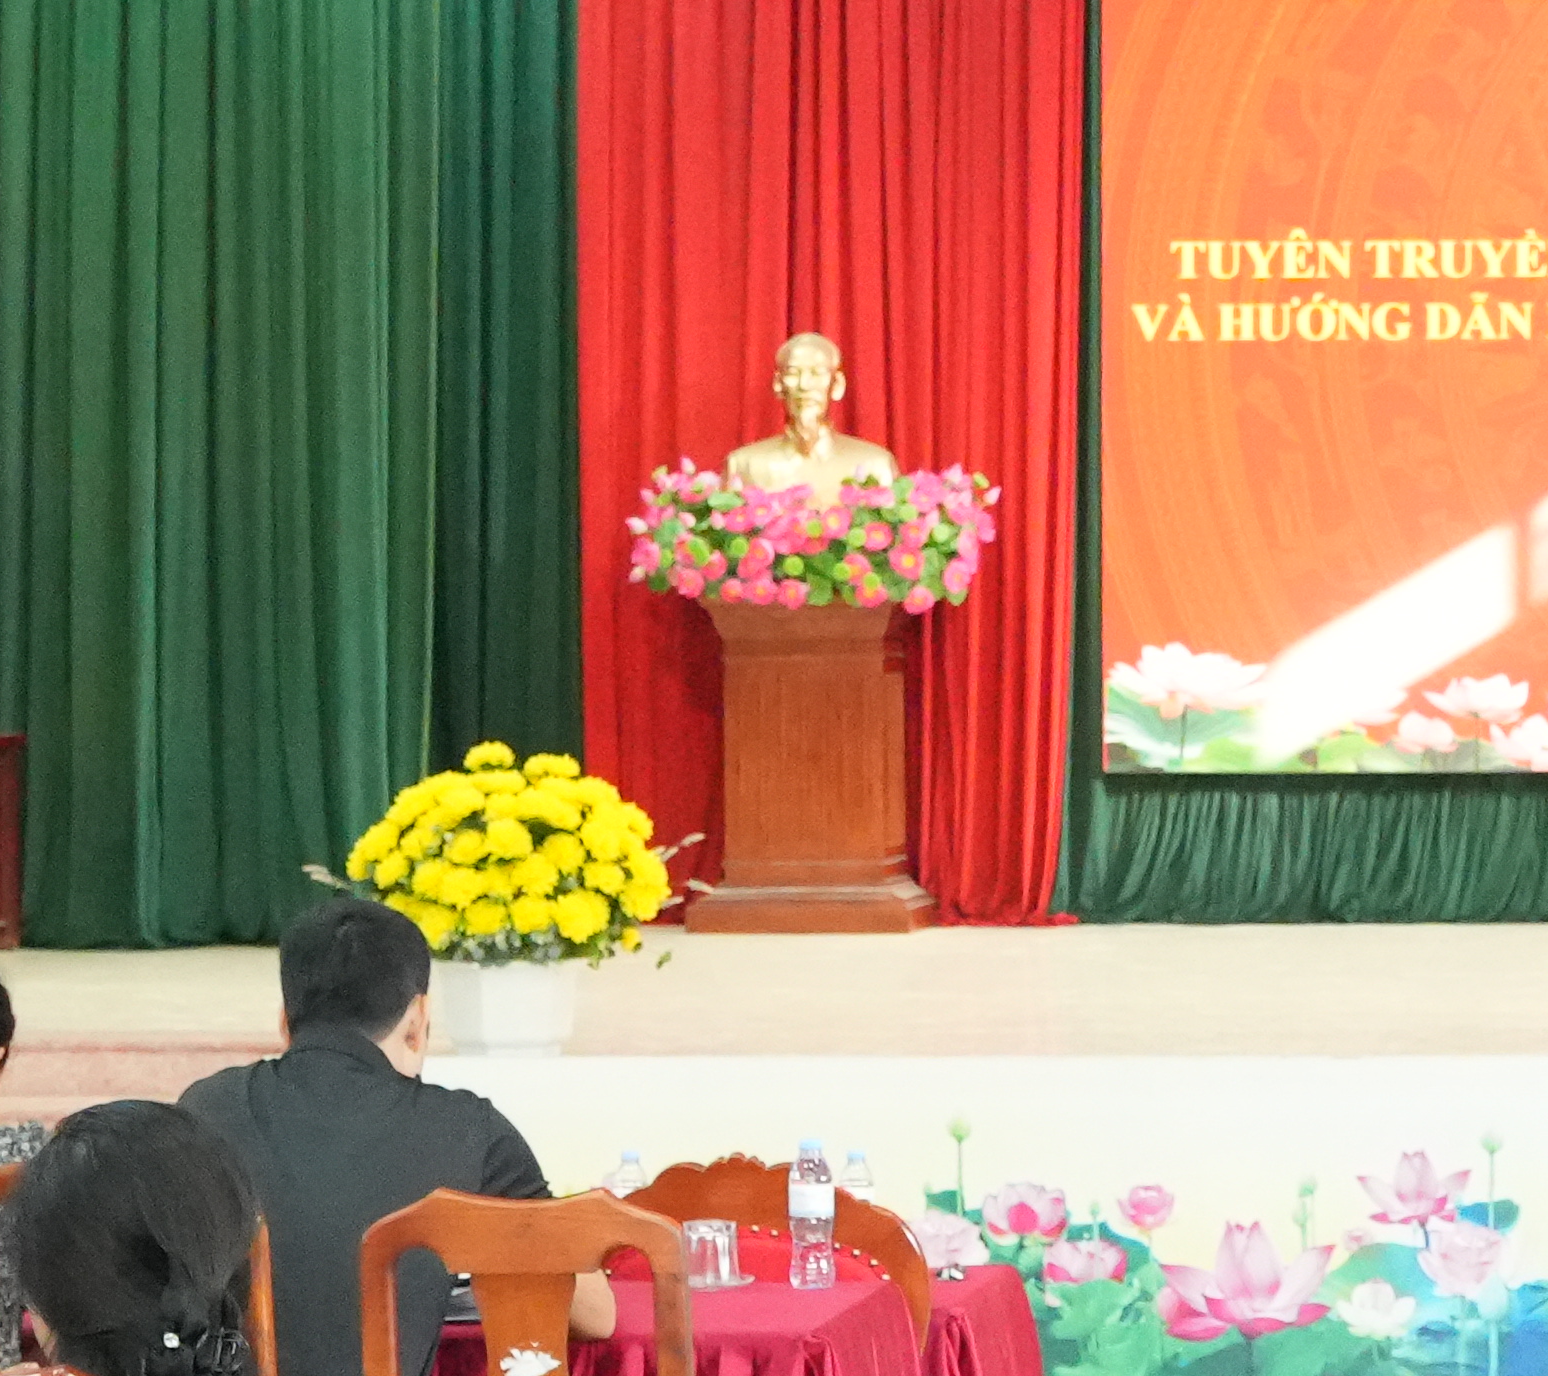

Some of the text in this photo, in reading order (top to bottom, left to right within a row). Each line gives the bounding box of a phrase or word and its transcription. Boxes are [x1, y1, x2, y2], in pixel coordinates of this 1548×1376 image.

[1170, 228, 1352, 278] TUYÊN
[1132, 293, 1203, 341] VÀ
[1220, 293, 1411, 341] HƯỚNG
[1426, 293, 1531, 339] DẪN
